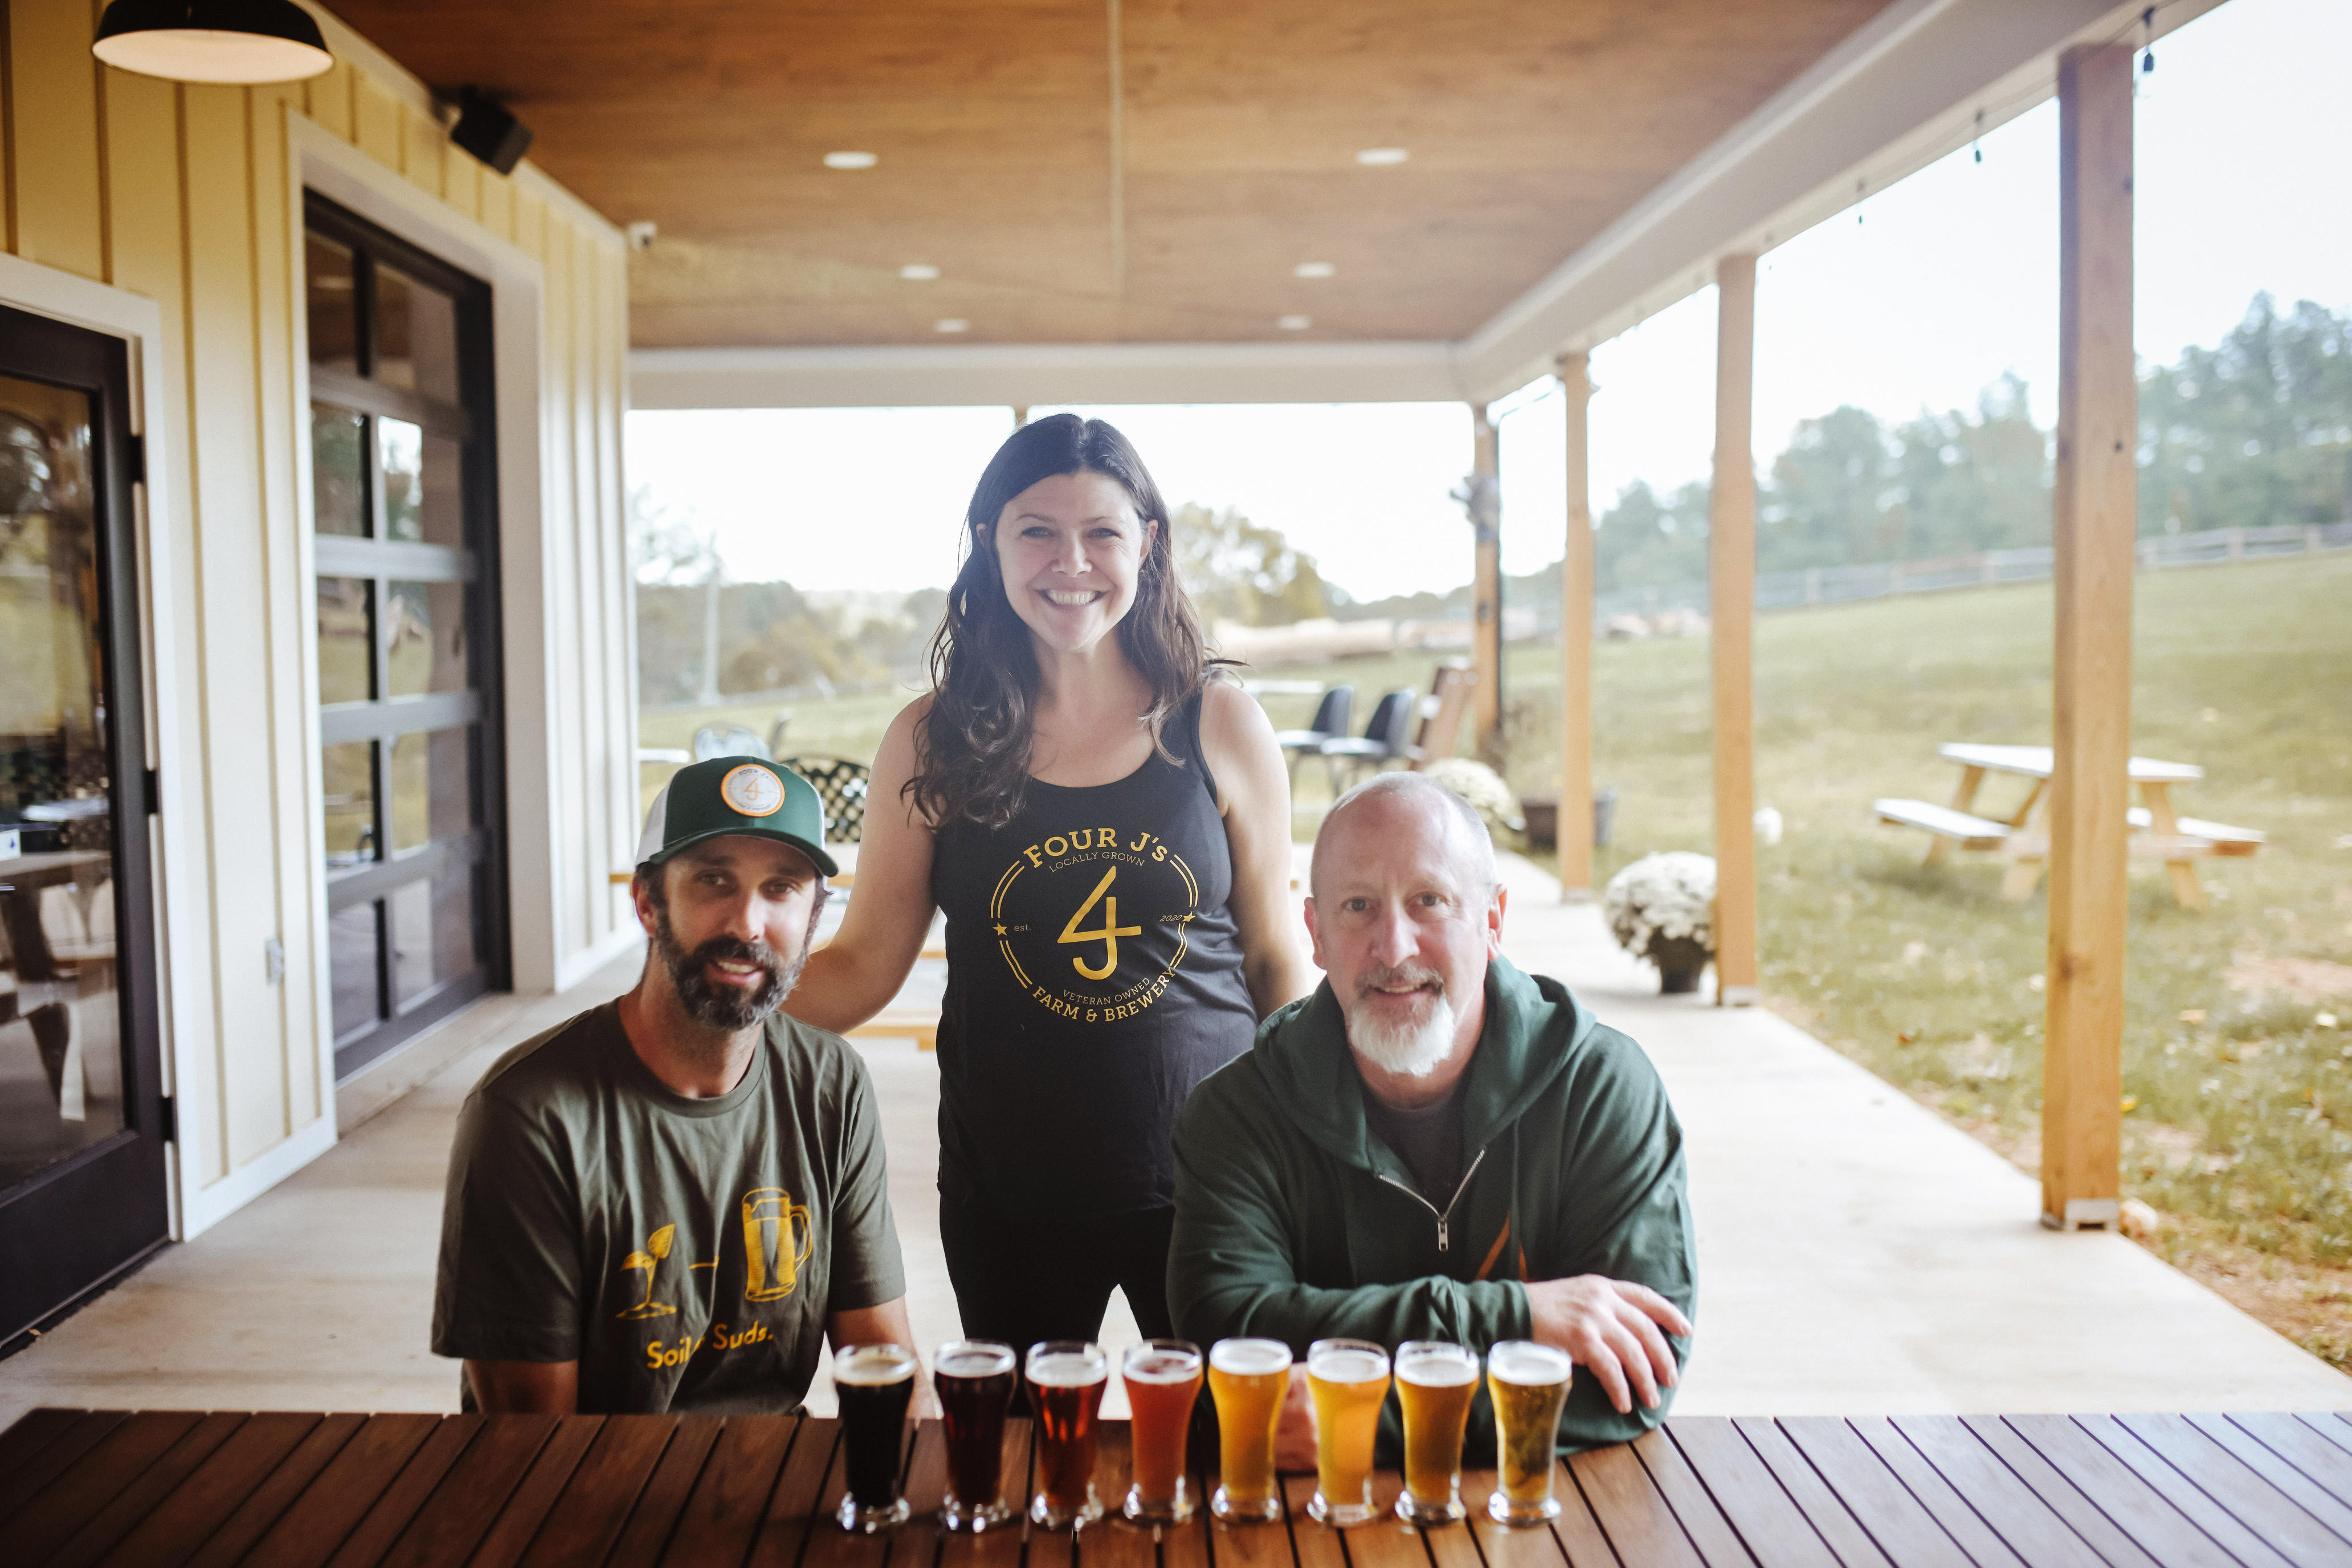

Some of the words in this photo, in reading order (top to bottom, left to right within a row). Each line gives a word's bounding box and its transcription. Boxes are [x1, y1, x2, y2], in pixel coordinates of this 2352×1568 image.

[1023, 828, 1117, 868] FOUR
[1130, 832, 1168, 862] J's
[1048, 852, 1098, 873] LOCALLY
[1102, 851, 1145, 867] GROWN
[1032, 986, 1080, 1020] FARM
[1085, 1008, 1097, 1022] &
[1105, 967, 1176, 1022] BREWERY
[1063, 989, 1111, 1005] VETERAN
[1114, 977, 1150, 1002] OWNED
[647, 1336, 692, 1369] Soil
[712, 1320, 774, 1350] Suds.
